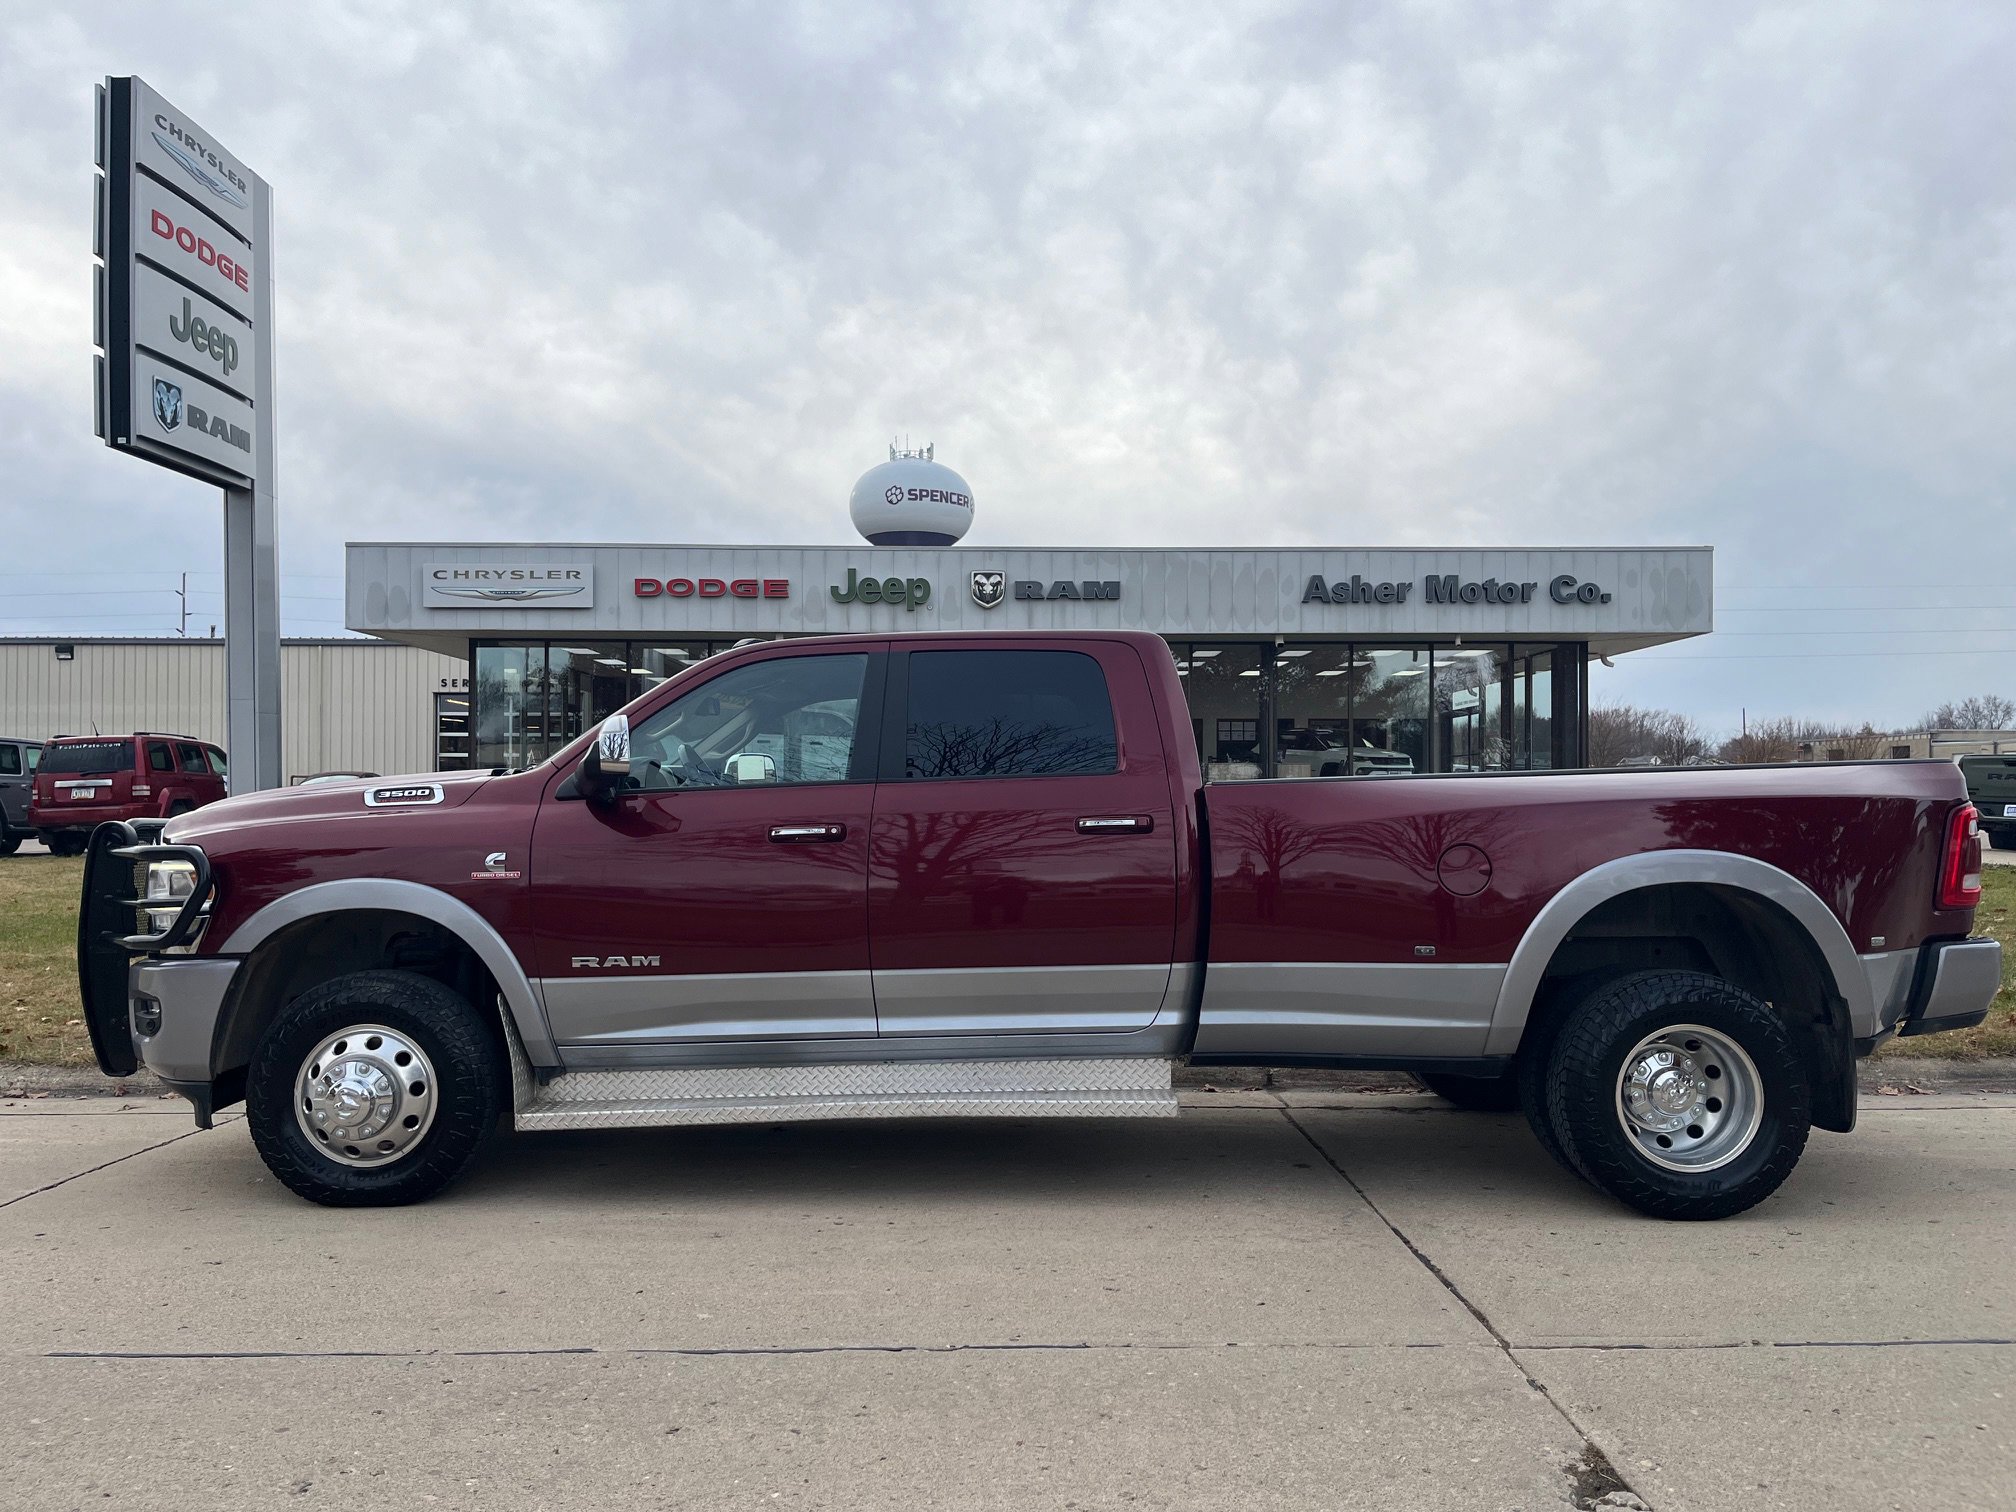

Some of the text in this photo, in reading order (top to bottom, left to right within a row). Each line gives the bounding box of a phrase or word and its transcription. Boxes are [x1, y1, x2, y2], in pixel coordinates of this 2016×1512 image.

[154, 113, 248, 195] CHRYSLER
[151, 208, 249, 293] DODGE
[169, 296, 239, 377] Jeep
[187, 403, 251, 454] RAM
[907, 488, 970, 508] SPENCER
[432, 570, 582, 580] CHRYSLER
[634, 578, 790, 598] DODGE
[830, 568, 931, 611] Jeep
[1014, 580, 1121, 601] RAM
[1301, 574, 1612, 604] Asher Motor Co.
[378, 789, 430, 798] 3500
[571, 955, 661, 968] RAM
